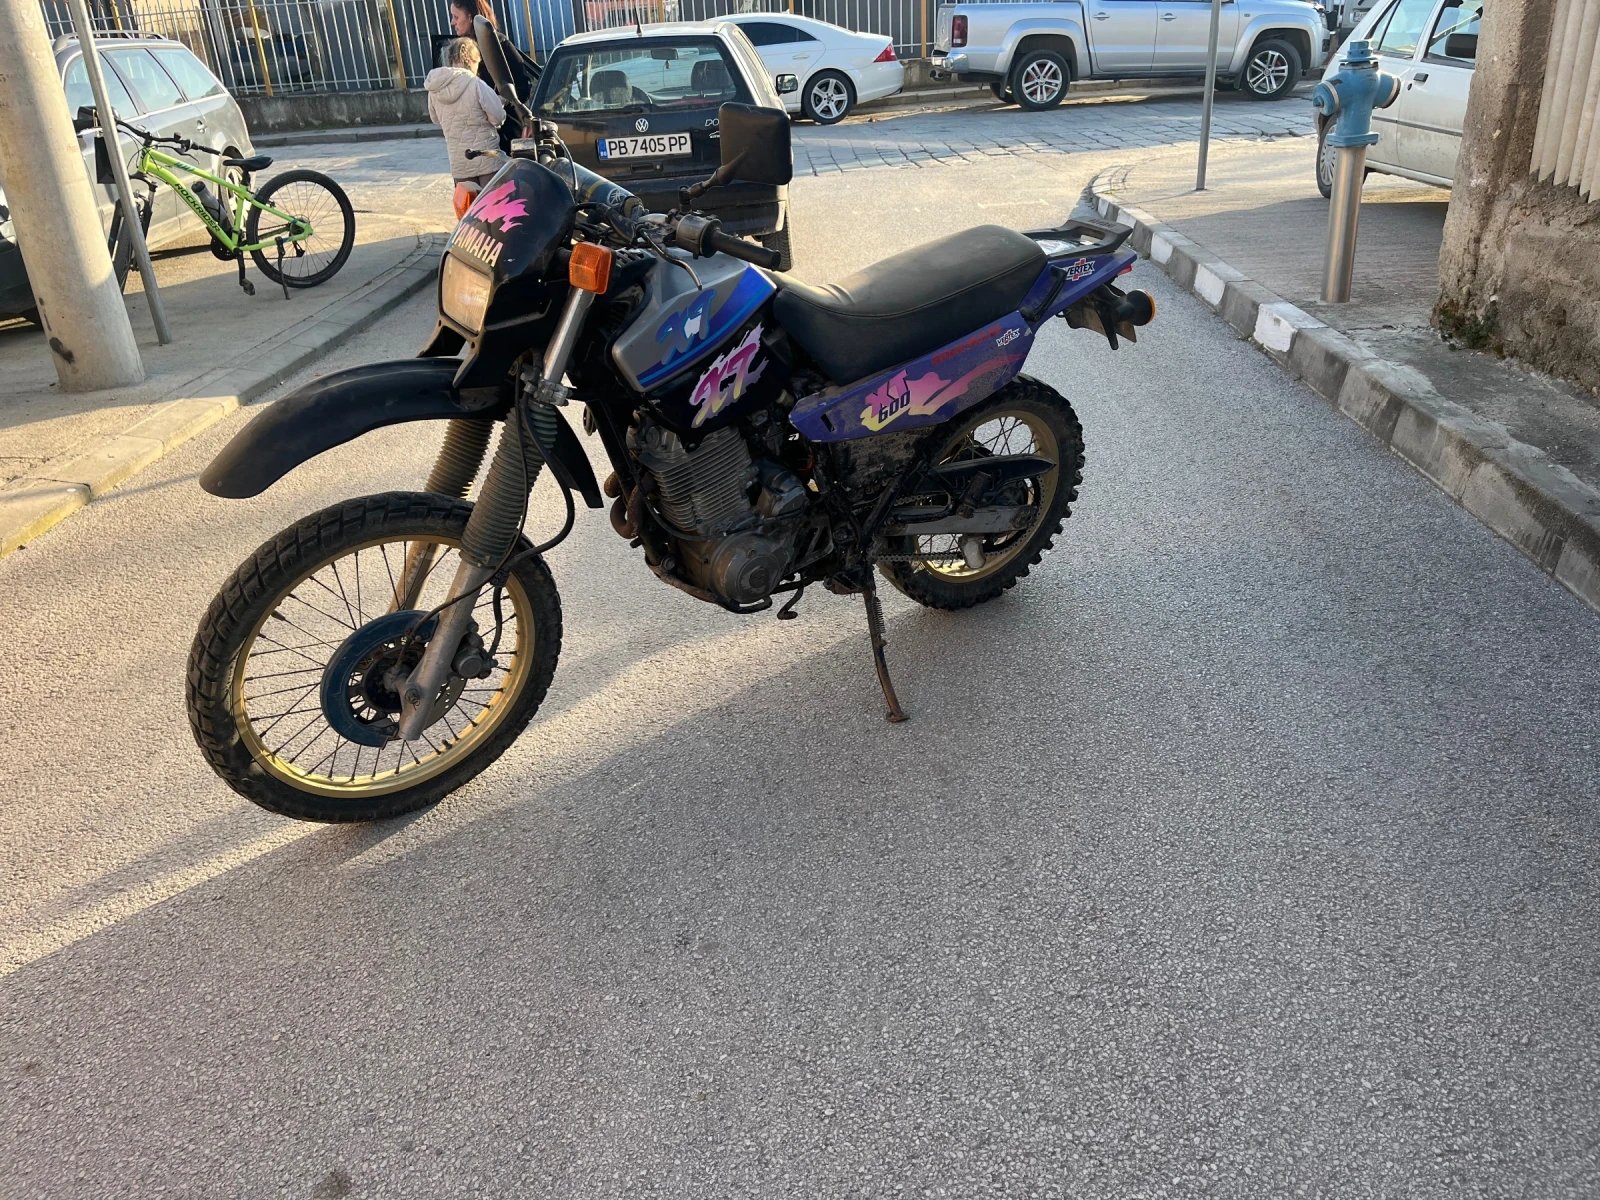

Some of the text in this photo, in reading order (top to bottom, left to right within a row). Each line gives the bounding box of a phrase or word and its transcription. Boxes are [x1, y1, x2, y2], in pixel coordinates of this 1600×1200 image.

[608, 135, 688, 156] PB 7405 PP
[174, 183, 221, 232] ROCKRIDER
[452, 222, 503, 268] YAMAHA
[690, 336, 761, 421] XT
[865, 369, 909, 418] XT
[878, 390, 911, 424] 600
